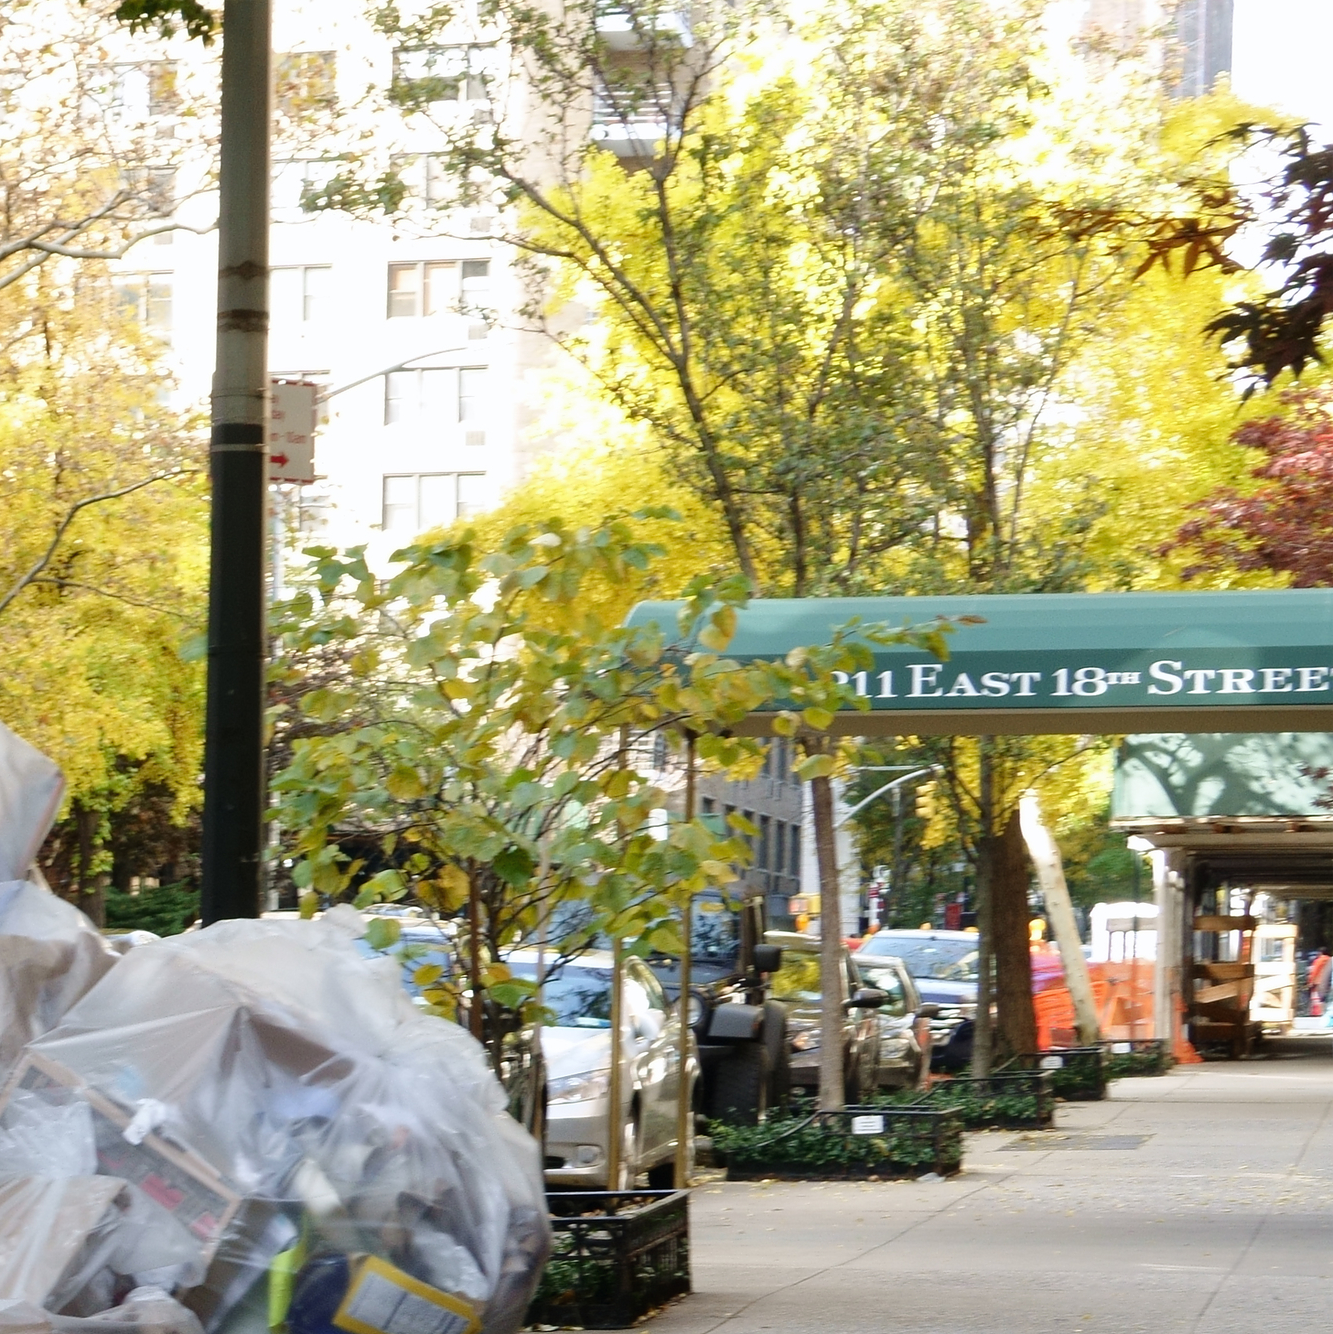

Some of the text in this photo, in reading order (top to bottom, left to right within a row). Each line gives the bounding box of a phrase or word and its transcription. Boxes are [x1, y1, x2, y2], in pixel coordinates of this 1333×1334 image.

[904, 663, 1041, 698] EAST
[1051, 666, 1141, 697] 18TH
[1147, 658, 1333, 696] STREE
